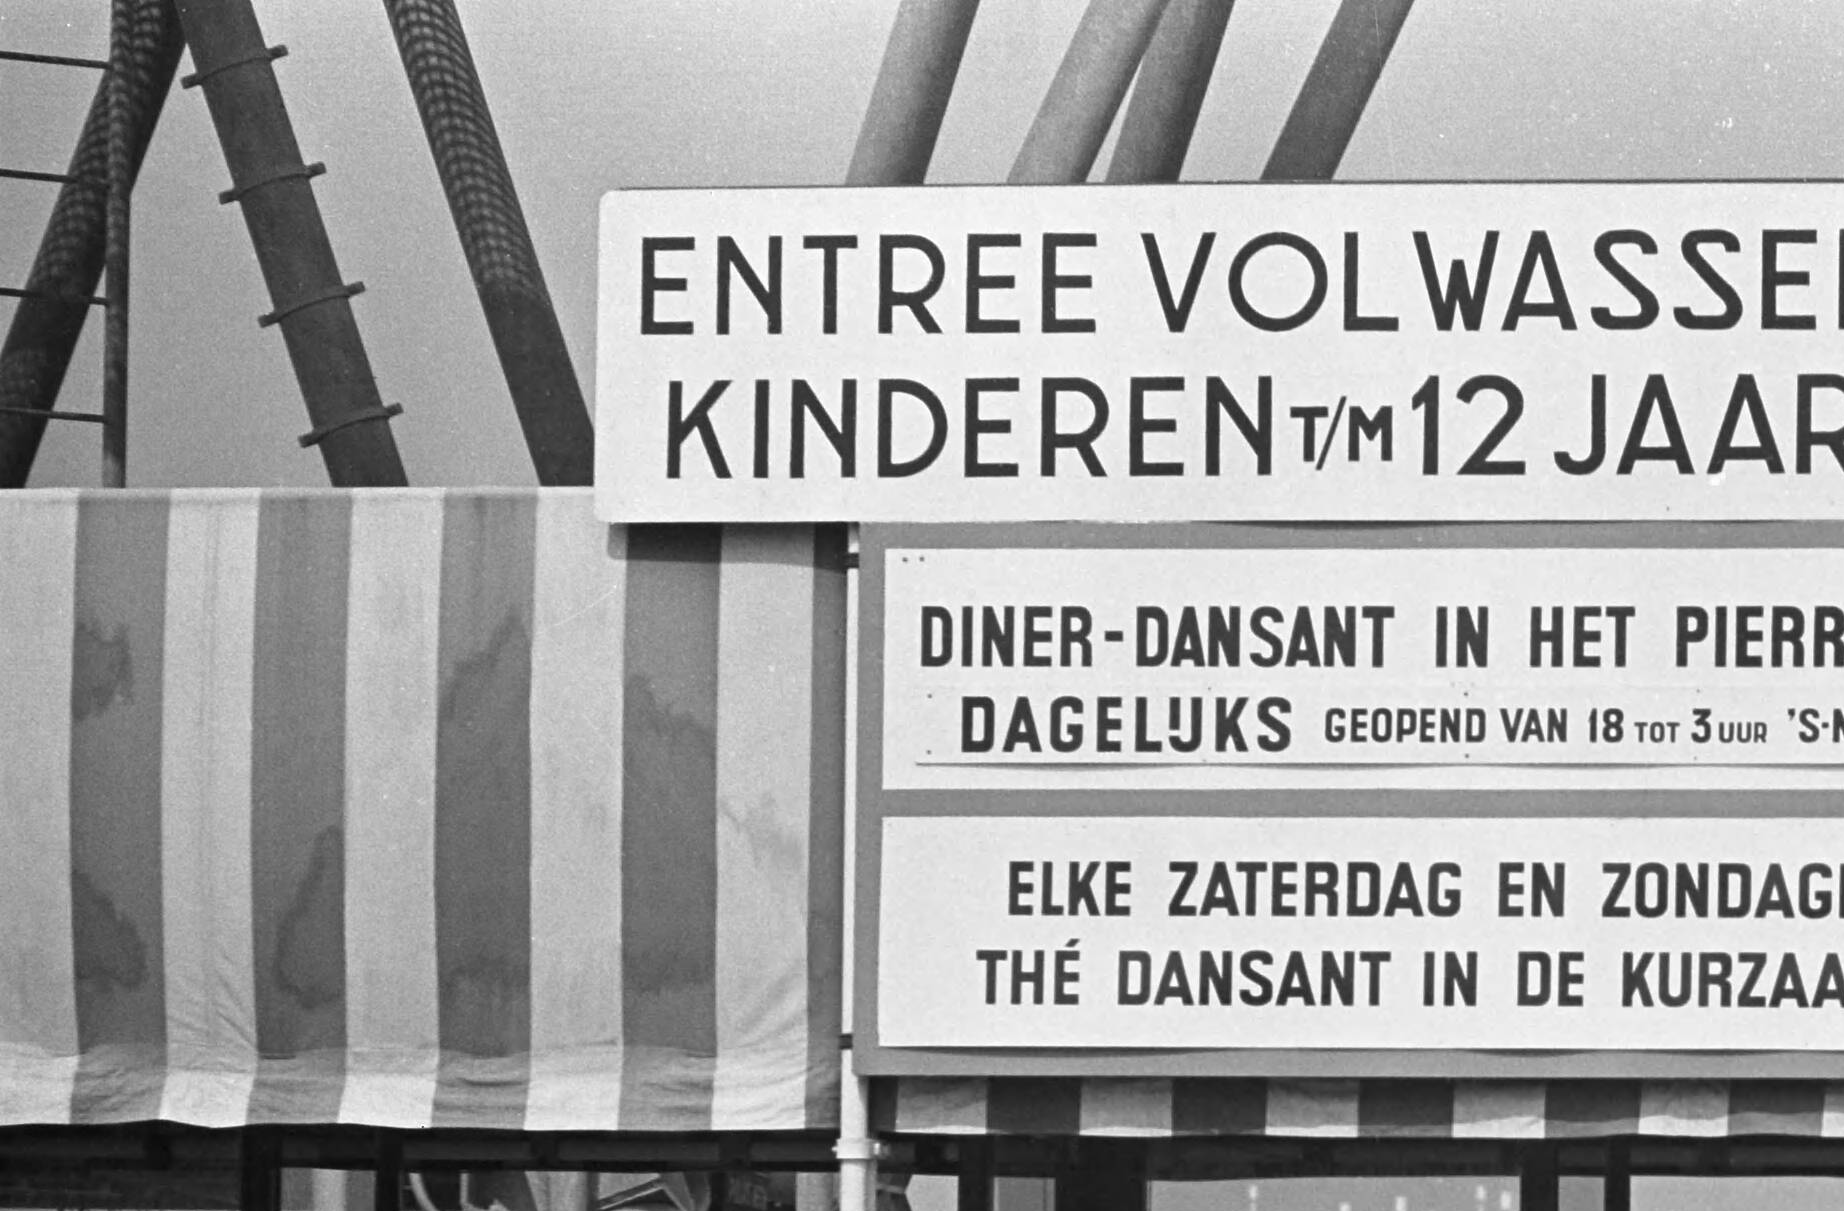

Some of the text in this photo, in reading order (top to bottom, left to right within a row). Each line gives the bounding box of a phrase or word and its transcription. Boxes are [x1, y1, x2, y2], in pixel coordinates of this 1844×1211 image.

[641, 233, 1097, 335] ENTREE
[667, 376, 1272, 479] KINDEREN
[1291, 396, 1393, 471] T/M
[1411, 375, 1526, 476] 12
[922, 606, 1395, 668] DINER-DANSANT
[1437, 606, 1489, 668] IN
[1531, 606, 1636, 668] HET
[961, 696, 1291, 753] DAGELIJKS
[1325, 708, 1486, 743] GEOPEND
[1501, 708, 1567, 743] VAN
[1589, 708, 1624, 743] 18
[1634, 722, 1680, 743] TOT
[1008, 861, 1131, 916] ELKE
[1168, 861, 1461, 917] ZATERDAG
[1498, 862, 1565, 917] EN
[977, 938, 1080, 1005] THÉ
[1118, 950, 1391, 1006] DANSANT
[1423, 951, 1478, 1007] IN
[1517, 951, 1584, 1007] DE
